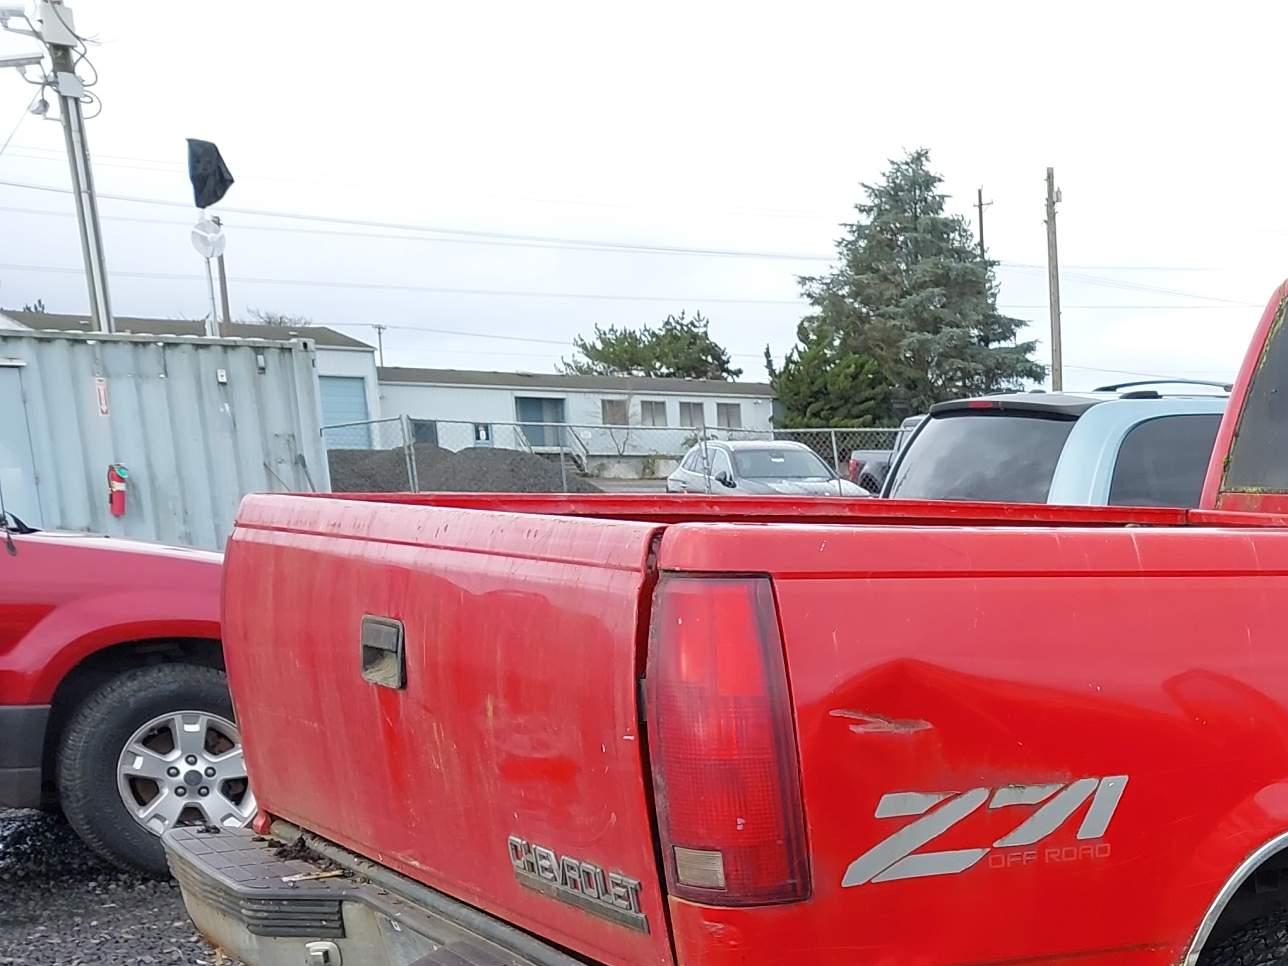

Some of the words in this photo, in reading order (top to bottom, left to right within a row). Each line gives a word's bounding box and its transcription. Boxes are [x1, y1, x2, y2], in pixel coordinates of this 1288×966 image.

[841, 775, 1129, 887] Z71
[988, 850, 1037, 868] OFF
[1045, 843, 1111, 862] ROAD
[508, 835, 642, 914] CHEVROLET
